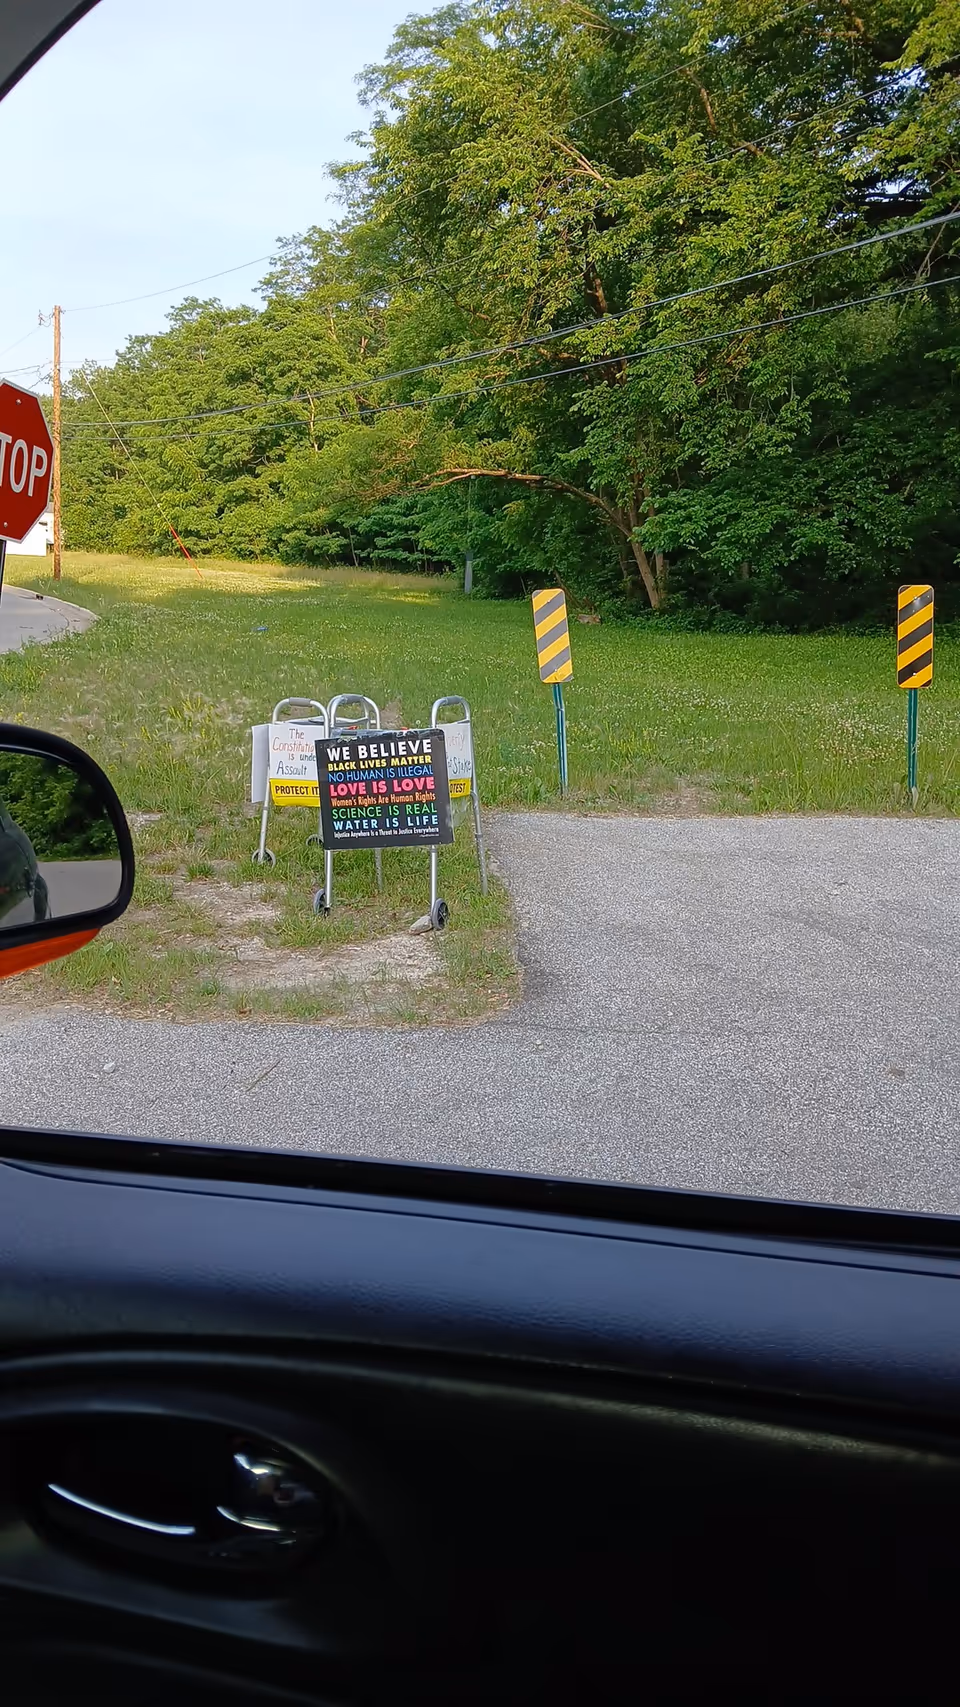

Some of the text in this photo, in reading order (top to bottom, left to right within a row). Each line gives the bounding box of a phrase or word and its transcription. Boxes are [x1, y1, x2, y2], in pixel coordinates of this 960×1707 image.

[0, 431, 48, 497] TOP
[289, 728, 304, 740] The
[272, 737, 314, 752] Constitutio
[327, 739, 432, 762] WE BELIEVE
[300, 751, 316, 762] unde
[328, 755, 432, 772] BLACK LIVES MATTER
[276, 761, 308, 775] Assault
[328, 765, 433, 782] NO HUMAN IS ILLEGAL
[275, 785, 309, 795] PROTECT
[330, 777, 435, 797] LOVE IS LOVE
[450, 783, 466, 794] OTEST
[331, 791, 436, 807] Women's Rights Are Human Rights
[332, 803, 437, 819] SCIENCE IS REAL
[333, 815, 438, 830] WATER IS LIFE
[350, 830, 370, 838] Anywhere
[414, 826, 439, 834] Everywhere
